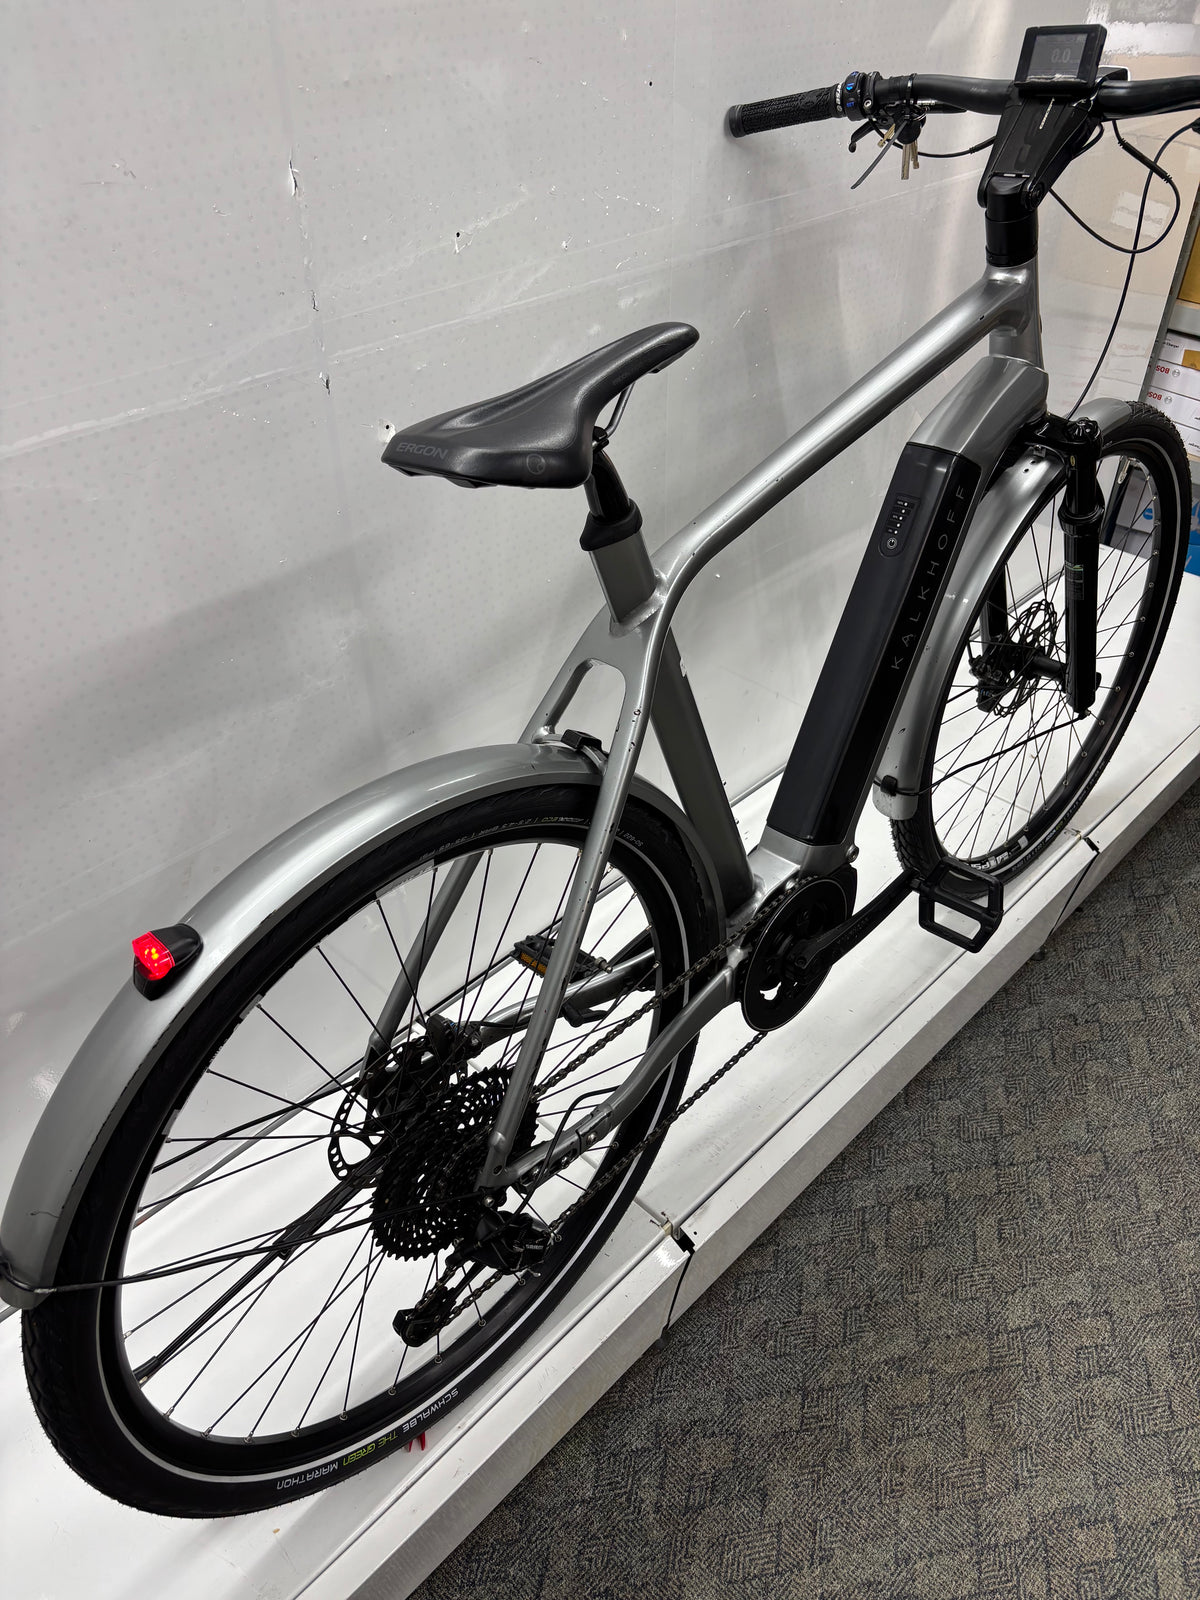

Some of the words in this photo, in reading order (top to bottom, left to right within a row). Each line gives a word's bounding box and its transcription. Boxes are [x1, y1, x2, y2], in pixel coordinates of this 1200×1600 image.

[1155, 364, 1171, 375] BOS
[1146, 391, 1163, 401] BOS
[396, 441, 449, 459] ERGON
[890, 485, 966, 670] KALKHOFF
[402, 1388, 459, 1433] SCHWALBE
[377, 1429, 399, 1449] THE
[342, 1442, 376, 1467] GREEN
[276, 1461, 339, 1491] MARATHON
